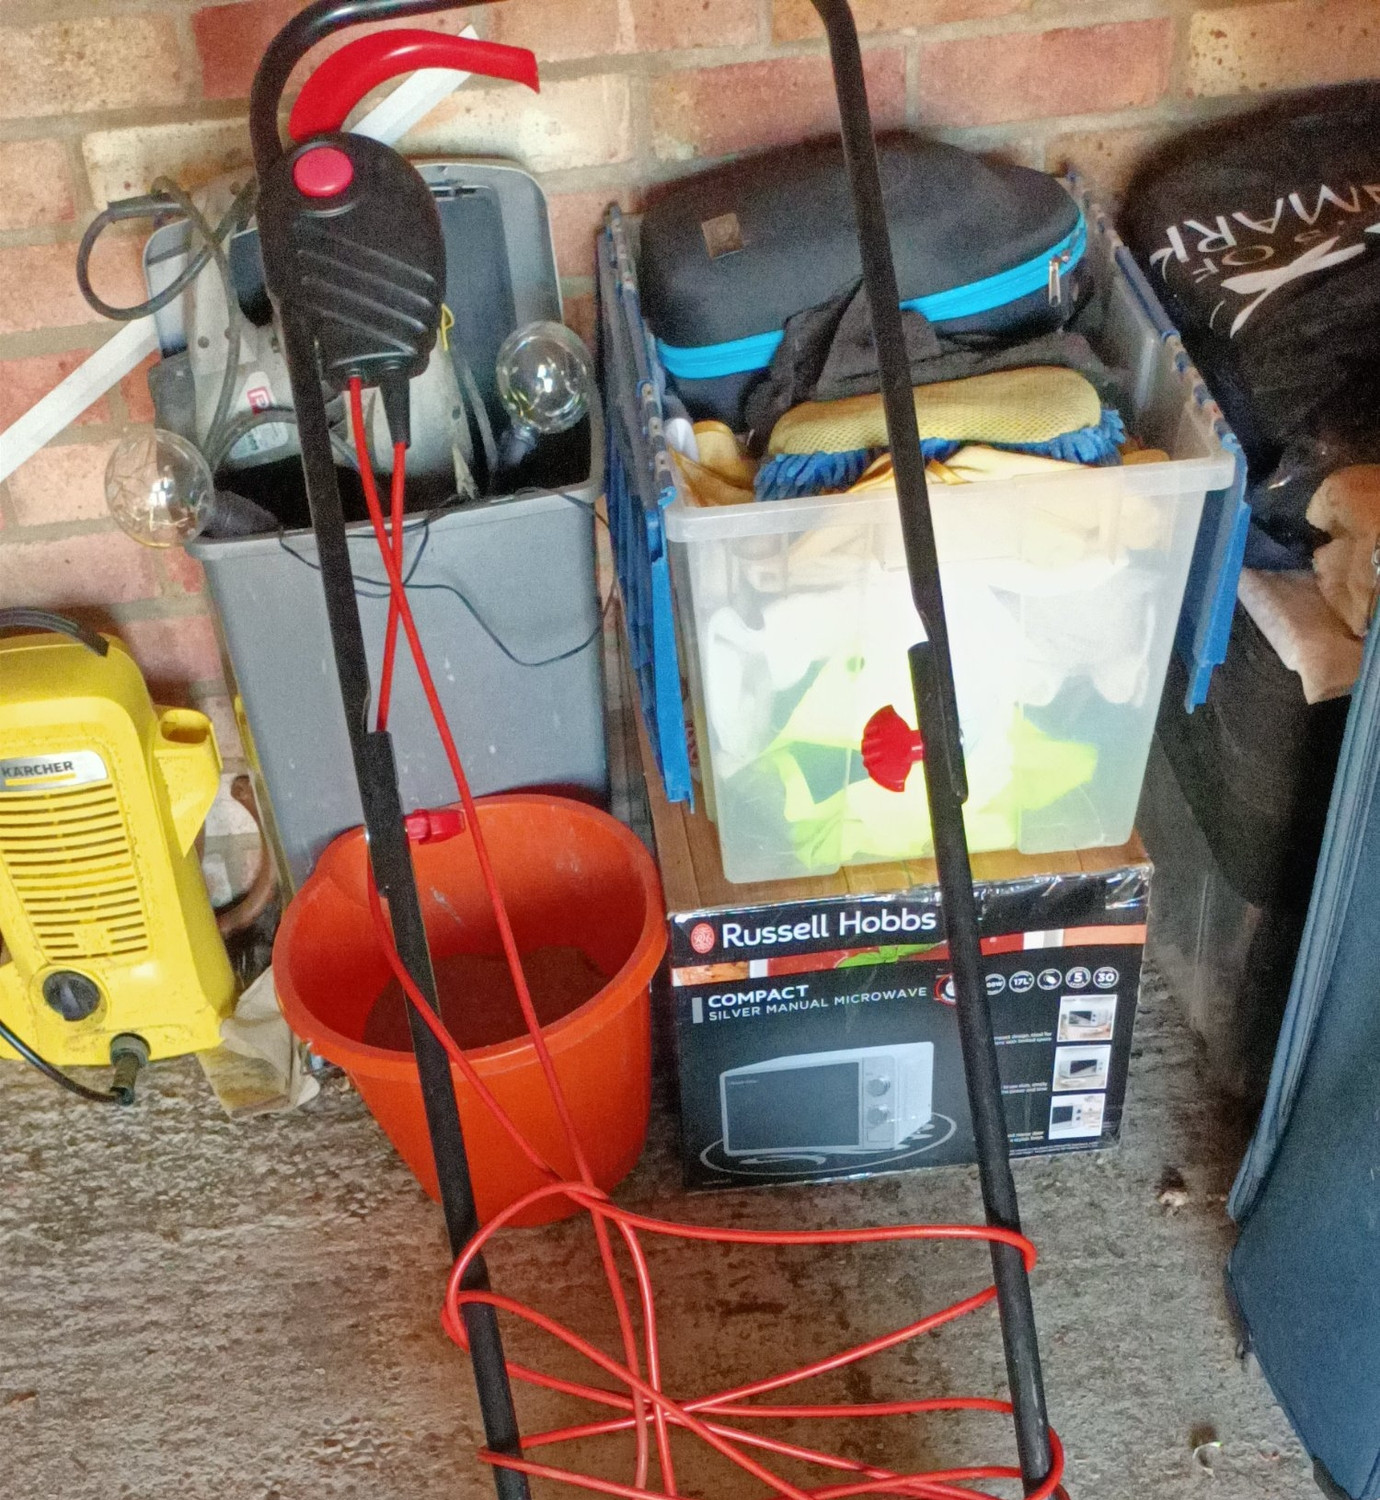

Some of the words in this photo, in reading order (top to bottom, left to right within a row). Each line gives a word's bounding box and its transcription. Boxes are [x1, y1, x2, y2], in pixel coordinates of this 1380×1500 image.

[722, 913, 829, 948] Russell
[839, 907, 937, 936] Hobbs
[1073, 972, 1083, 983] 5
[1097, 973, 1116, 983] 30
[708, 984, 809, 1008] COMPACT
[708, 1006, 761, 1021] SILVER
[766, 999, 829, 1014] MANUAL
[834, 987, 928, 1006] MICROWAVE
